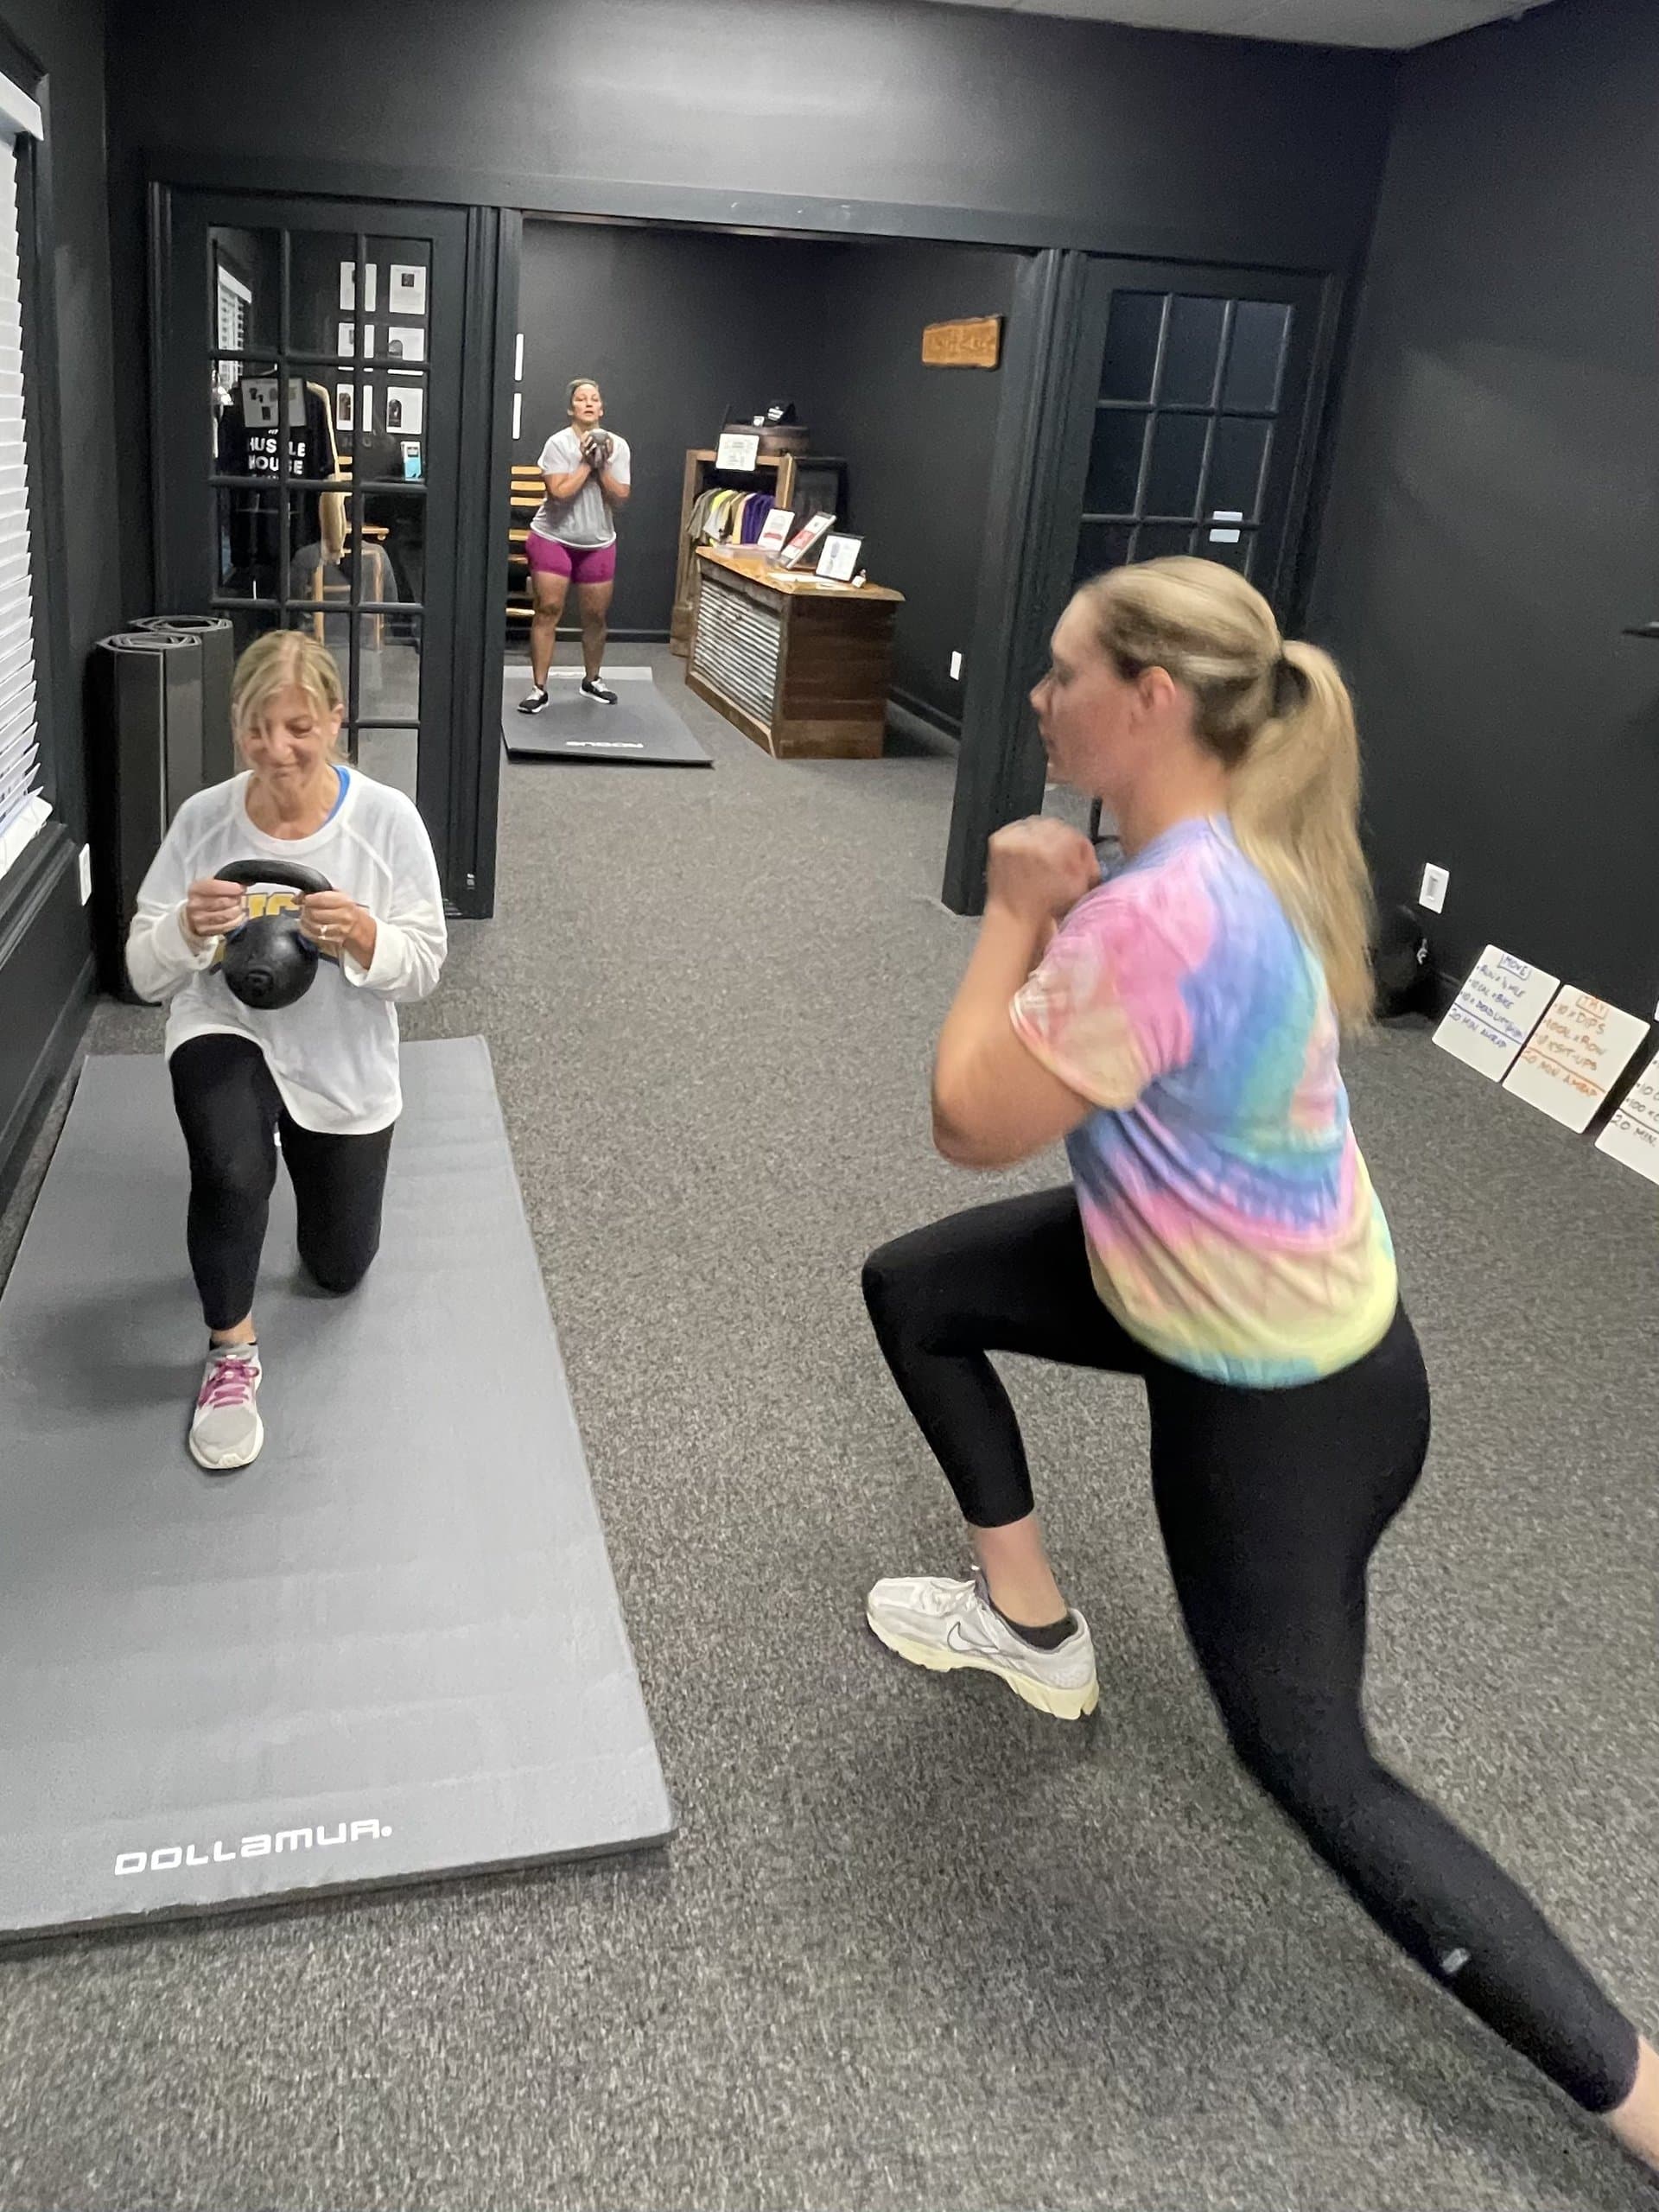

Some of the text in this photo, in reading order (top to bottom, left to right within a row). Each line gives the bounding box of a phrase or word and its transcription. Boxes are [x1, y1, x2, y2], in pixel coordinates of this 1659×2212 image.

[248, 436, 306, 457] HUSLE
[1503, 954, 1529, 976] MOVE
[1629, 1099, 1646, 1113] 100
[1610, 1114, 1631, 1130] 20
